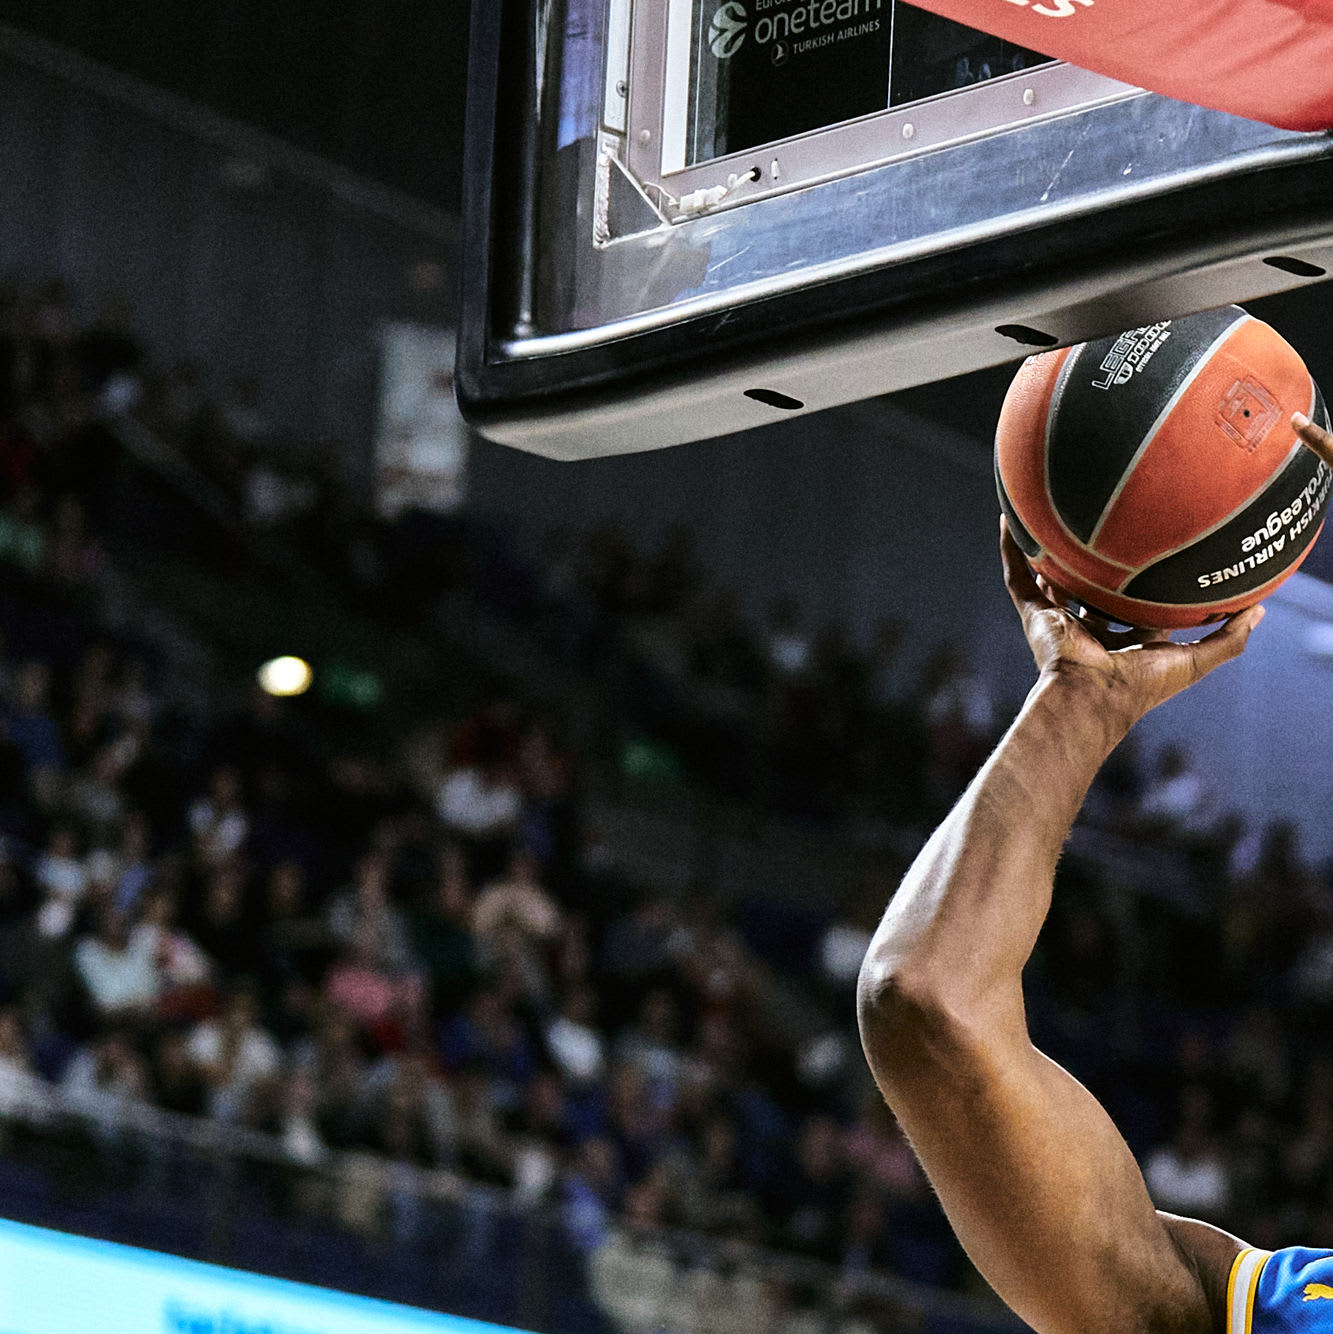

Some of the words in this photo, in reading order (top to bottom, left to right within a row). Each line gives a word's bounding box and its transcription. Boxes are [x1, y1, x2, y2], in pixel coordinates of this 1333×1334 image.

[793, 32, 835, 54] TURKISH
[837, 19, 881, 41] AIRLINES
[1241, 459, 1330, 553] uroLeague
[1197, 534, 1286, 588] AIRLINES
